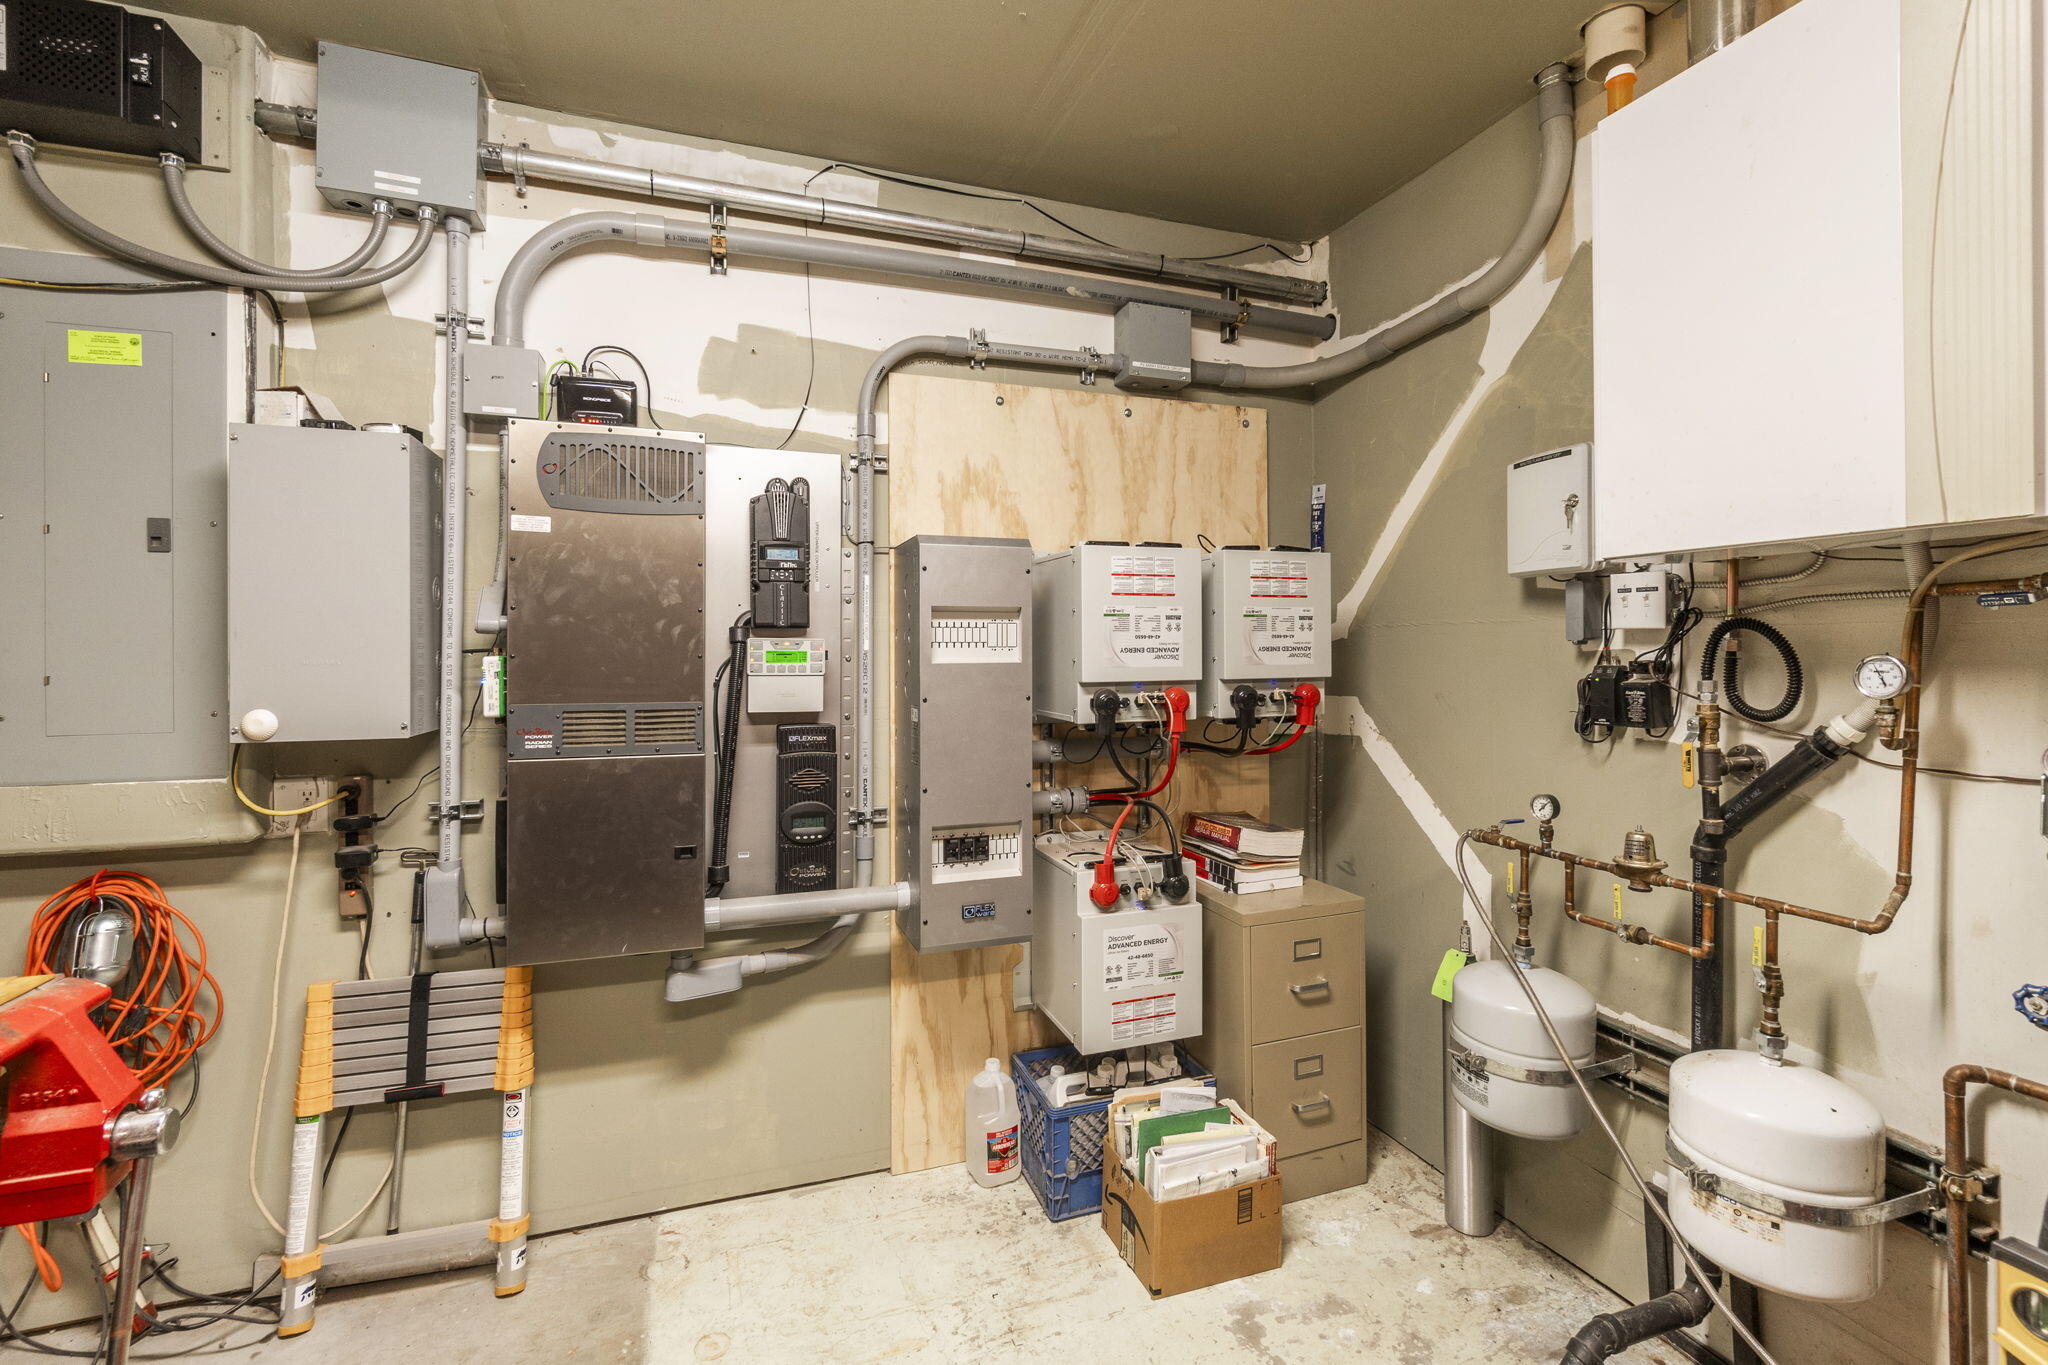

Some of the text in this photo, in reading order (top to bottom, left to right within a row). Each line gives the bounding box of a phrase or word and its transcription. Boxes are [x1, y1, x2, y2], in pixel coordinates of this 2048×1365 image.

[953, 271, 972, 279] CANTEX
[996, 348, 1022, 357] RESISTANT
[1153, 653, 1180, 661] Discover
[1194, 826, 1231, 842] REPAIR MANUAL
[975, 903, 995, 911] FLEX
[1108, 934, 1135, 943] Discover
[1107, 937, 1169, 950] ADVANCED ENERGY
[503, 1130, 523, 1138] NOTICE
